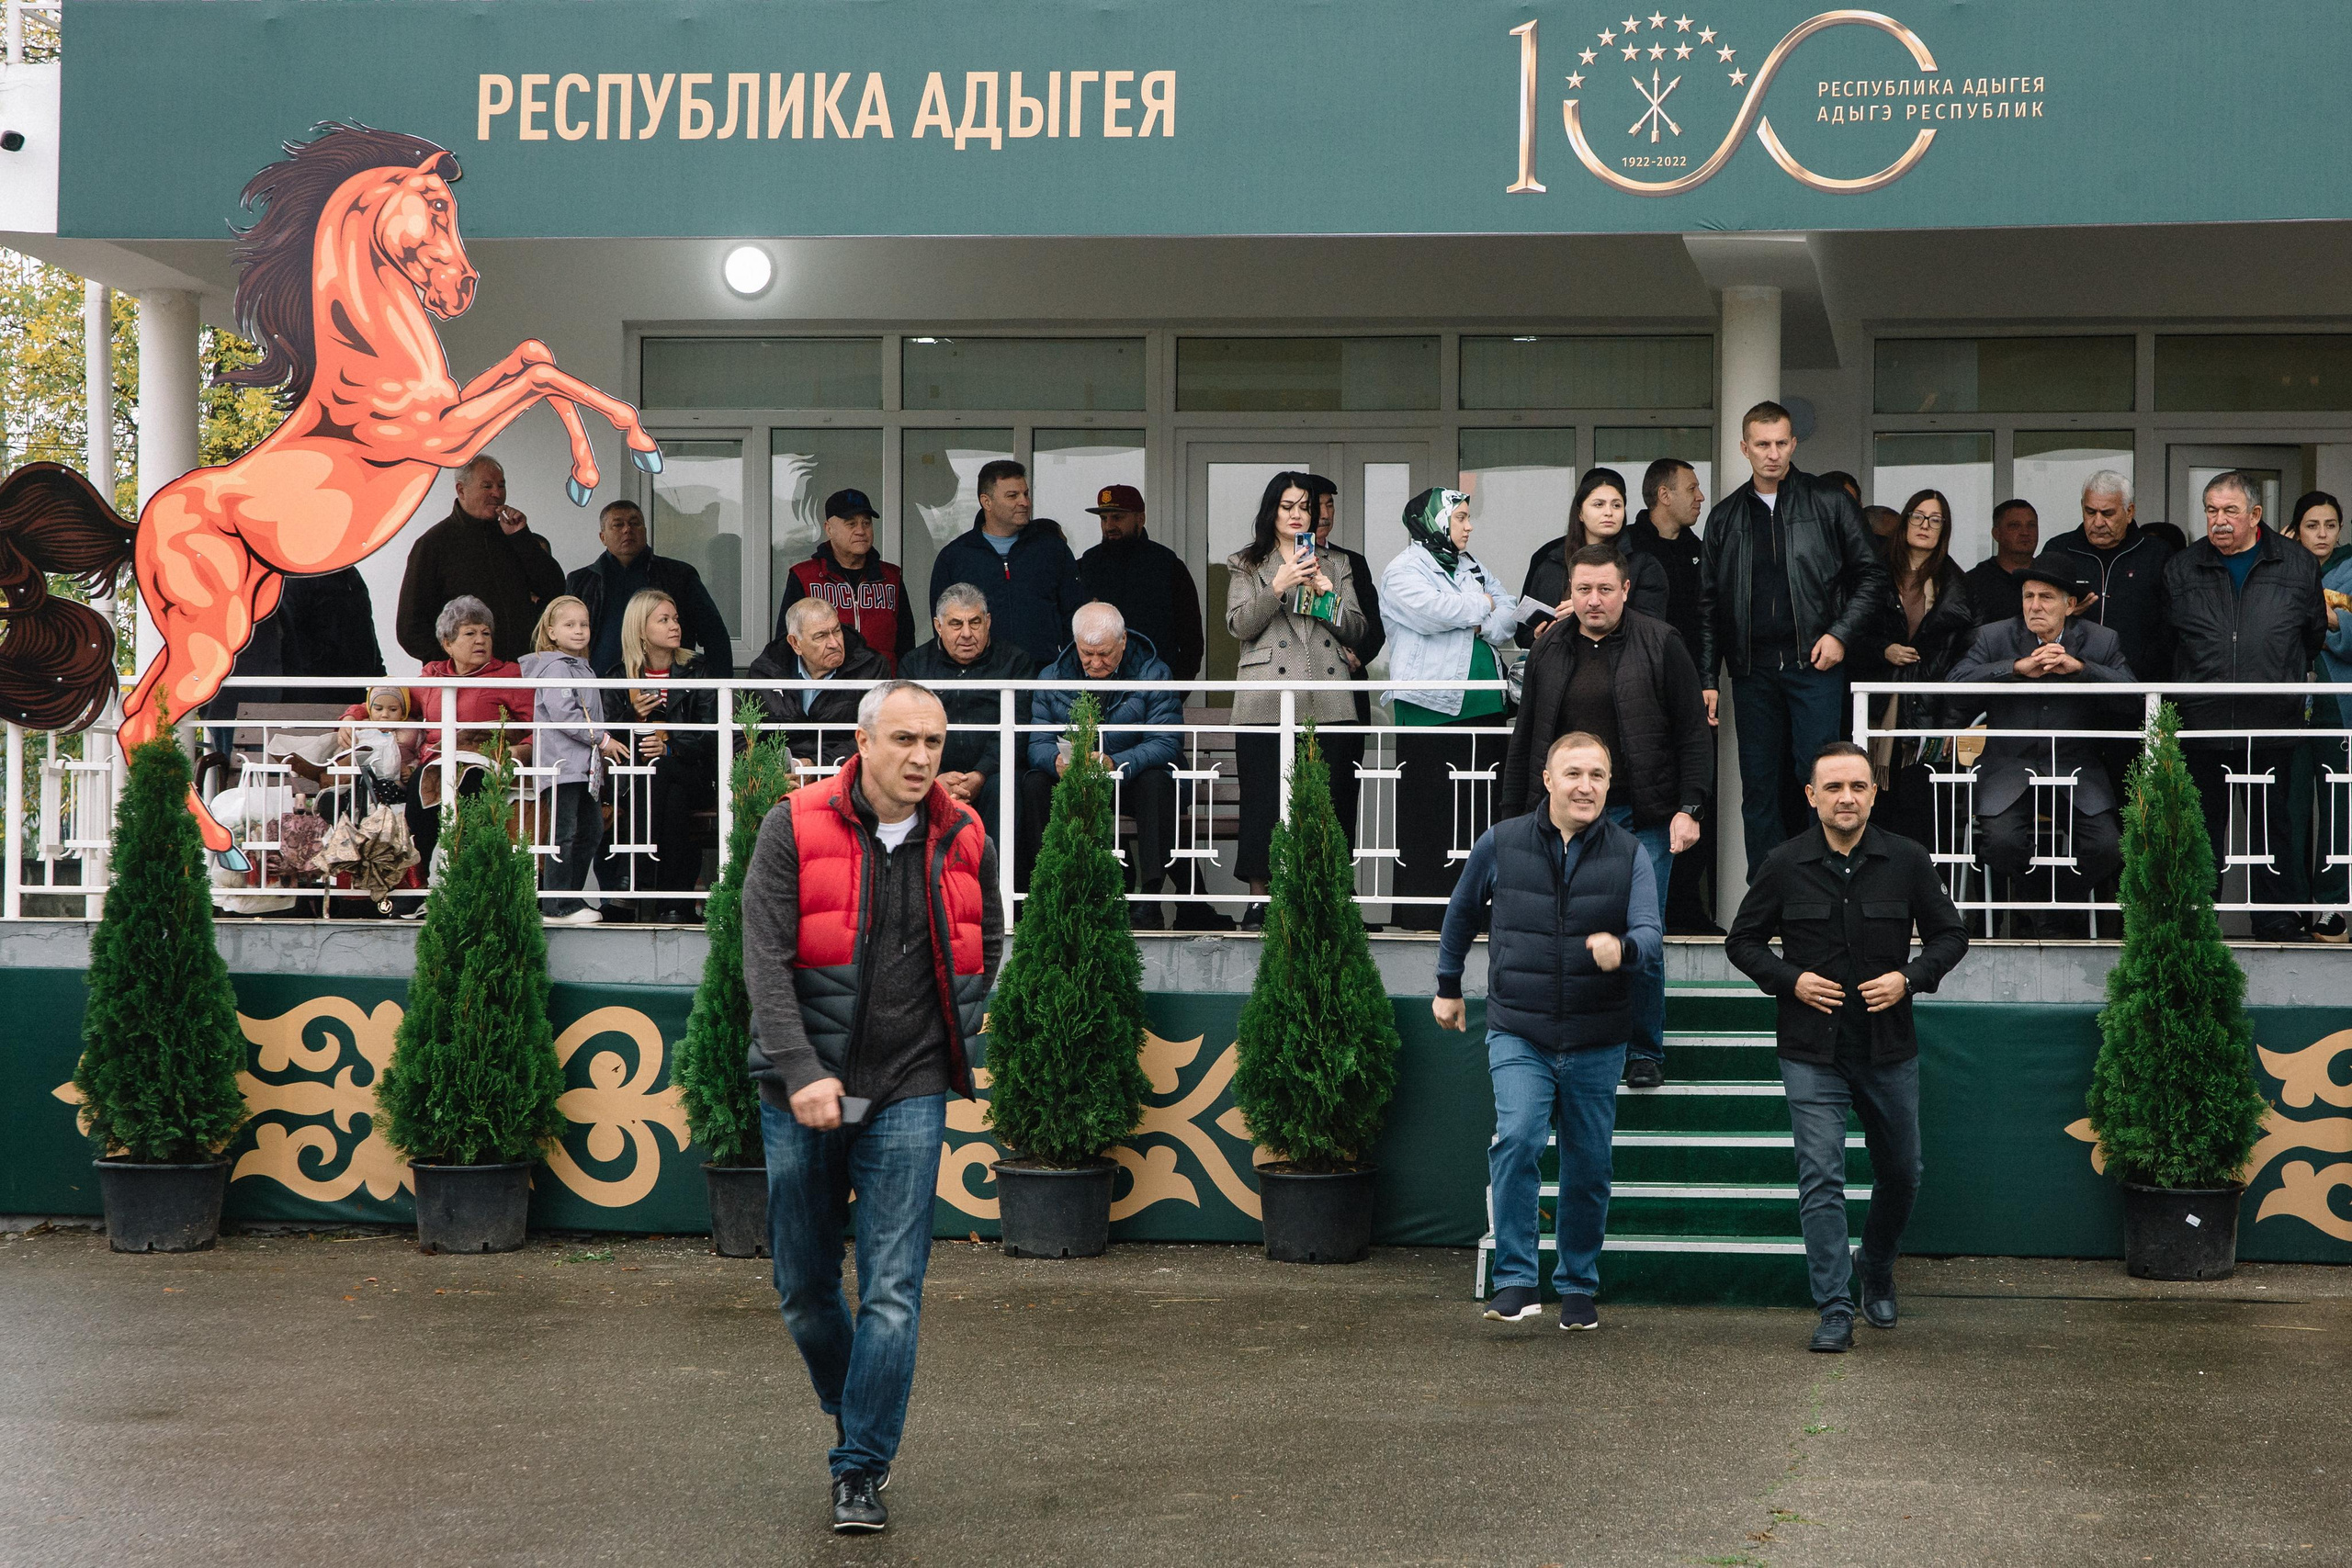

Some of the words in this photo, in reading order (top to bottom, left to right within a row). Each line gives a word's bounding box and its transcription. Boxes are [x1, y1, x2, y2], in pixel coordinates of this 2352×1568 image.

[1818, 79, 1954, 97] РЕСПУБЛИКА
[1962, 76, 2045, 97] АДЫГЕЯ
[477, 72, 894, 141] РЕСПУБЛИКА
[911, 70, 1177, 151] АДЫГЕЯ
[1816, 105, 1893, 125] АДЫГЭ
[1905, 101, 2044, 120] РЕСПУБЛИК
[1622, 156, 1687, 167] 1922-2022
